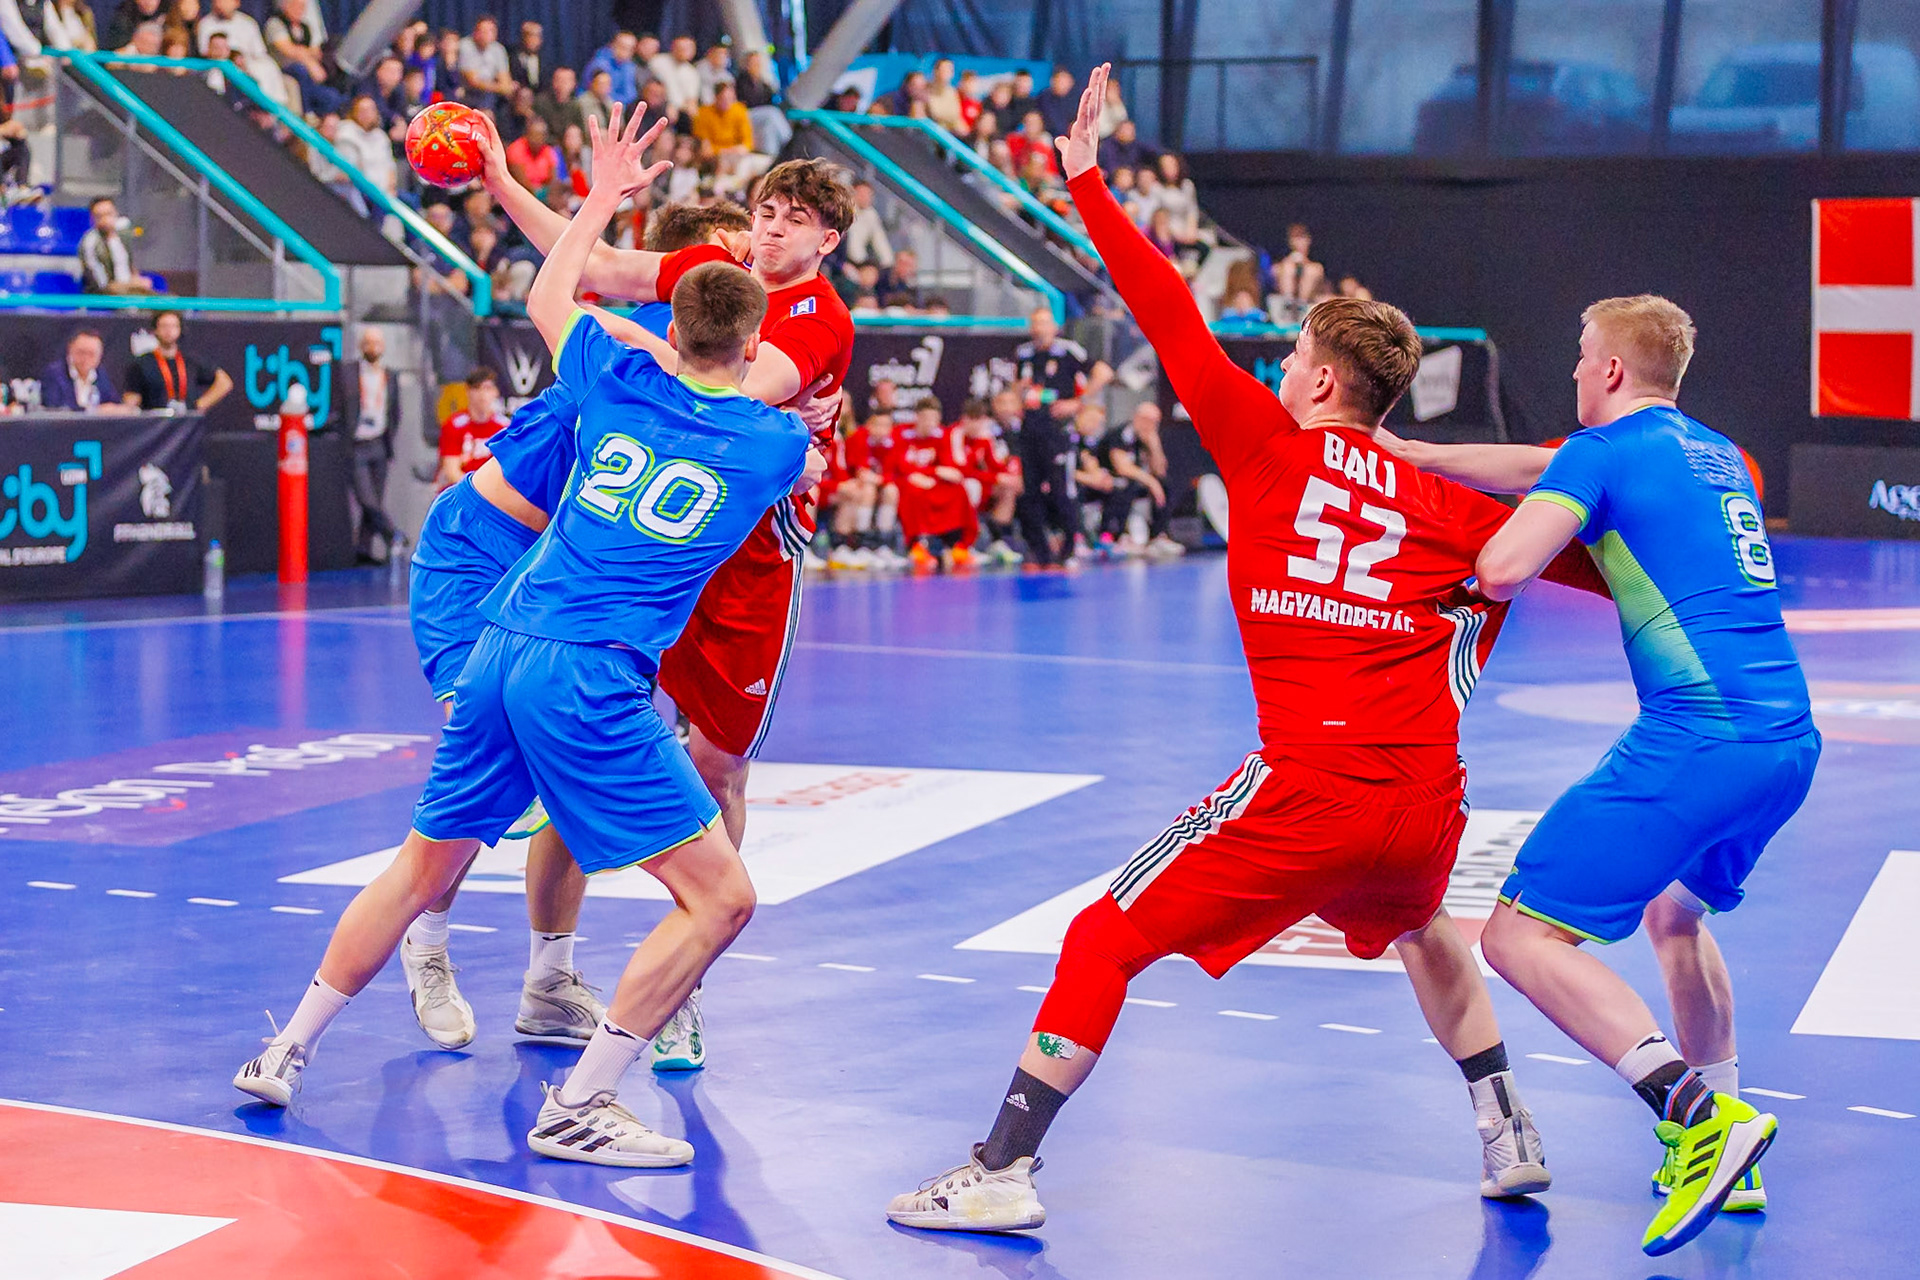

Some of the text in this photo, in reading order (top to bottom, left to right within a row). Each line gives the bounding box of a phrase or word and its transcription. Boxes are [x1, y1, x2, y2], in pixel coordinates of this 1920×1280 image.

[576, 432, 727, 544] 20
[1323, 430, 1397, 499] BALI
[1286, 474, 1408, 602] 52
[1720, 491, 1778, 588] 8
